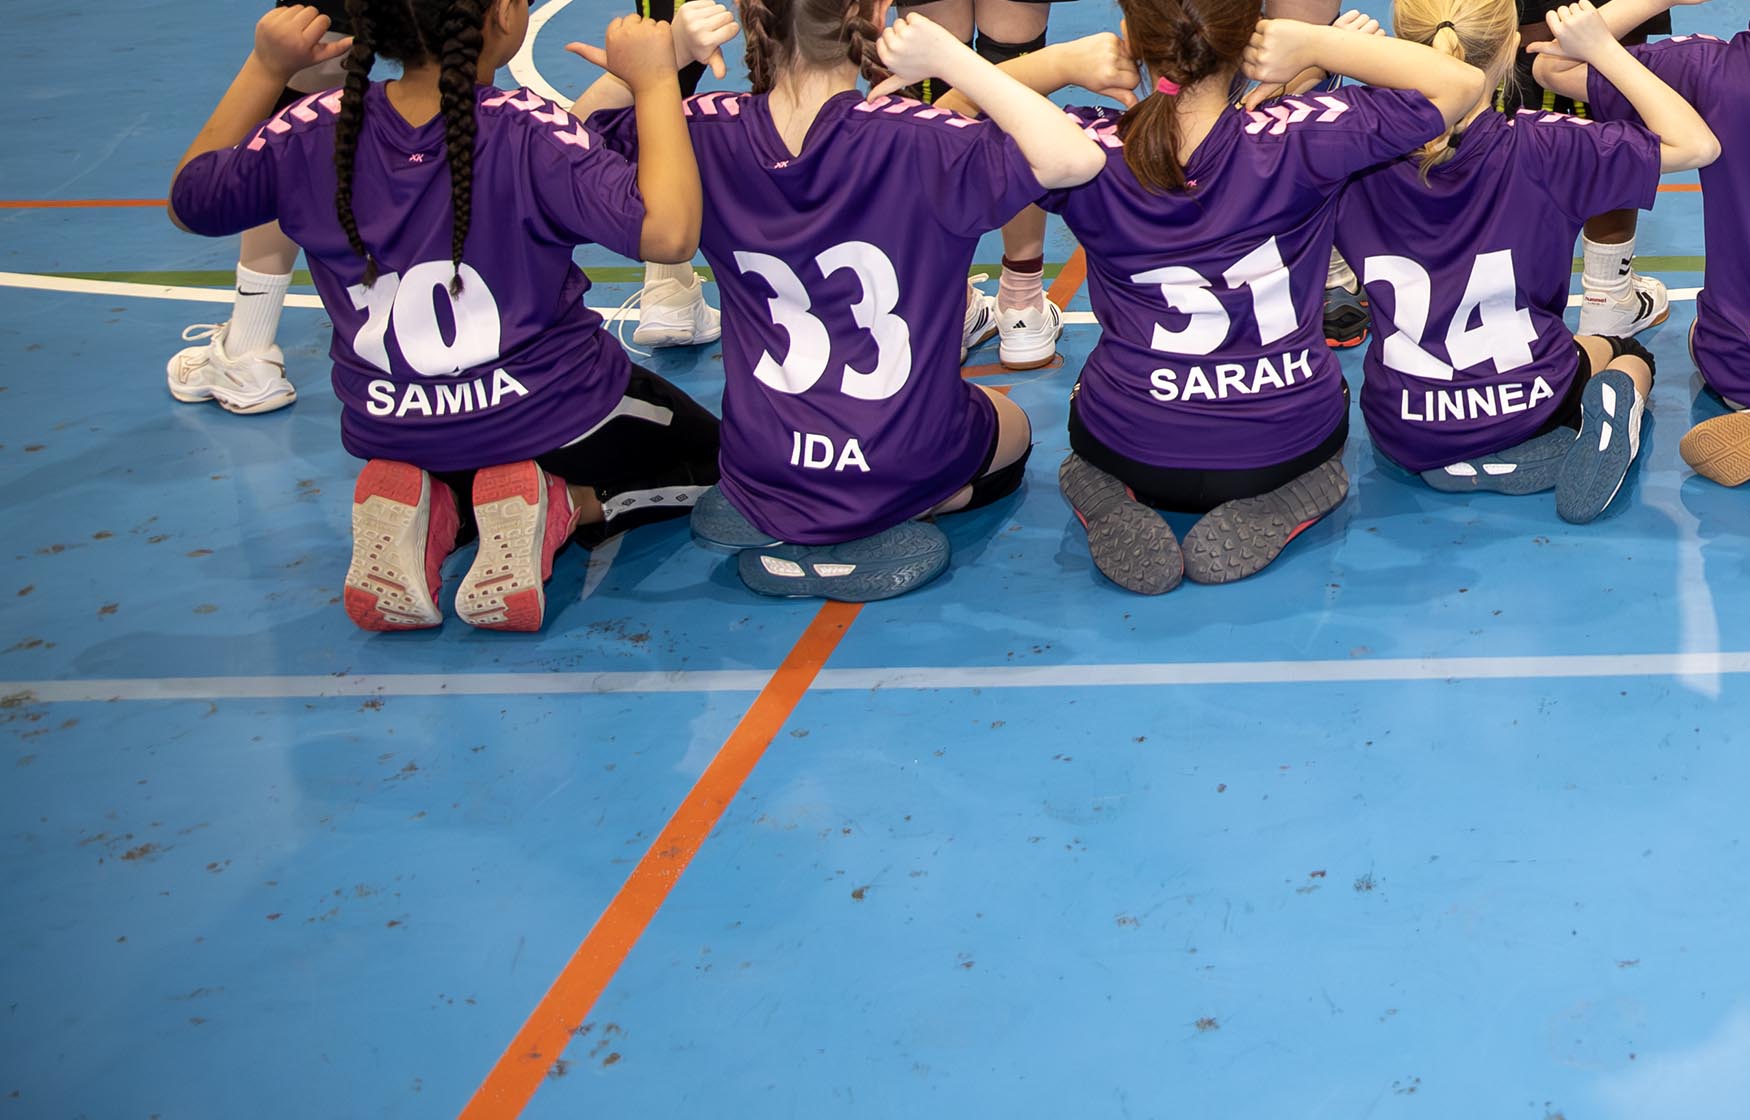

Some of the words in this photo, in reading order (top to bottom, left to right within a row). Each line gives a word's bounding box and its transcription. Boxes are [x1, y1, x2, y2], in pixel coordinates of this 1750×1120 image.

[733, 240, 912, 401] 33
[1130, 235, 1300, 355] 31
[1363, 248, 1539, 382] 24
[366, 367, 529, 417] SAMIA
[1149, 349, 1313, 402] SARAH
[1400, 375, 1554, 422] LINNEA
[790, 431, 871, 472] IDA
